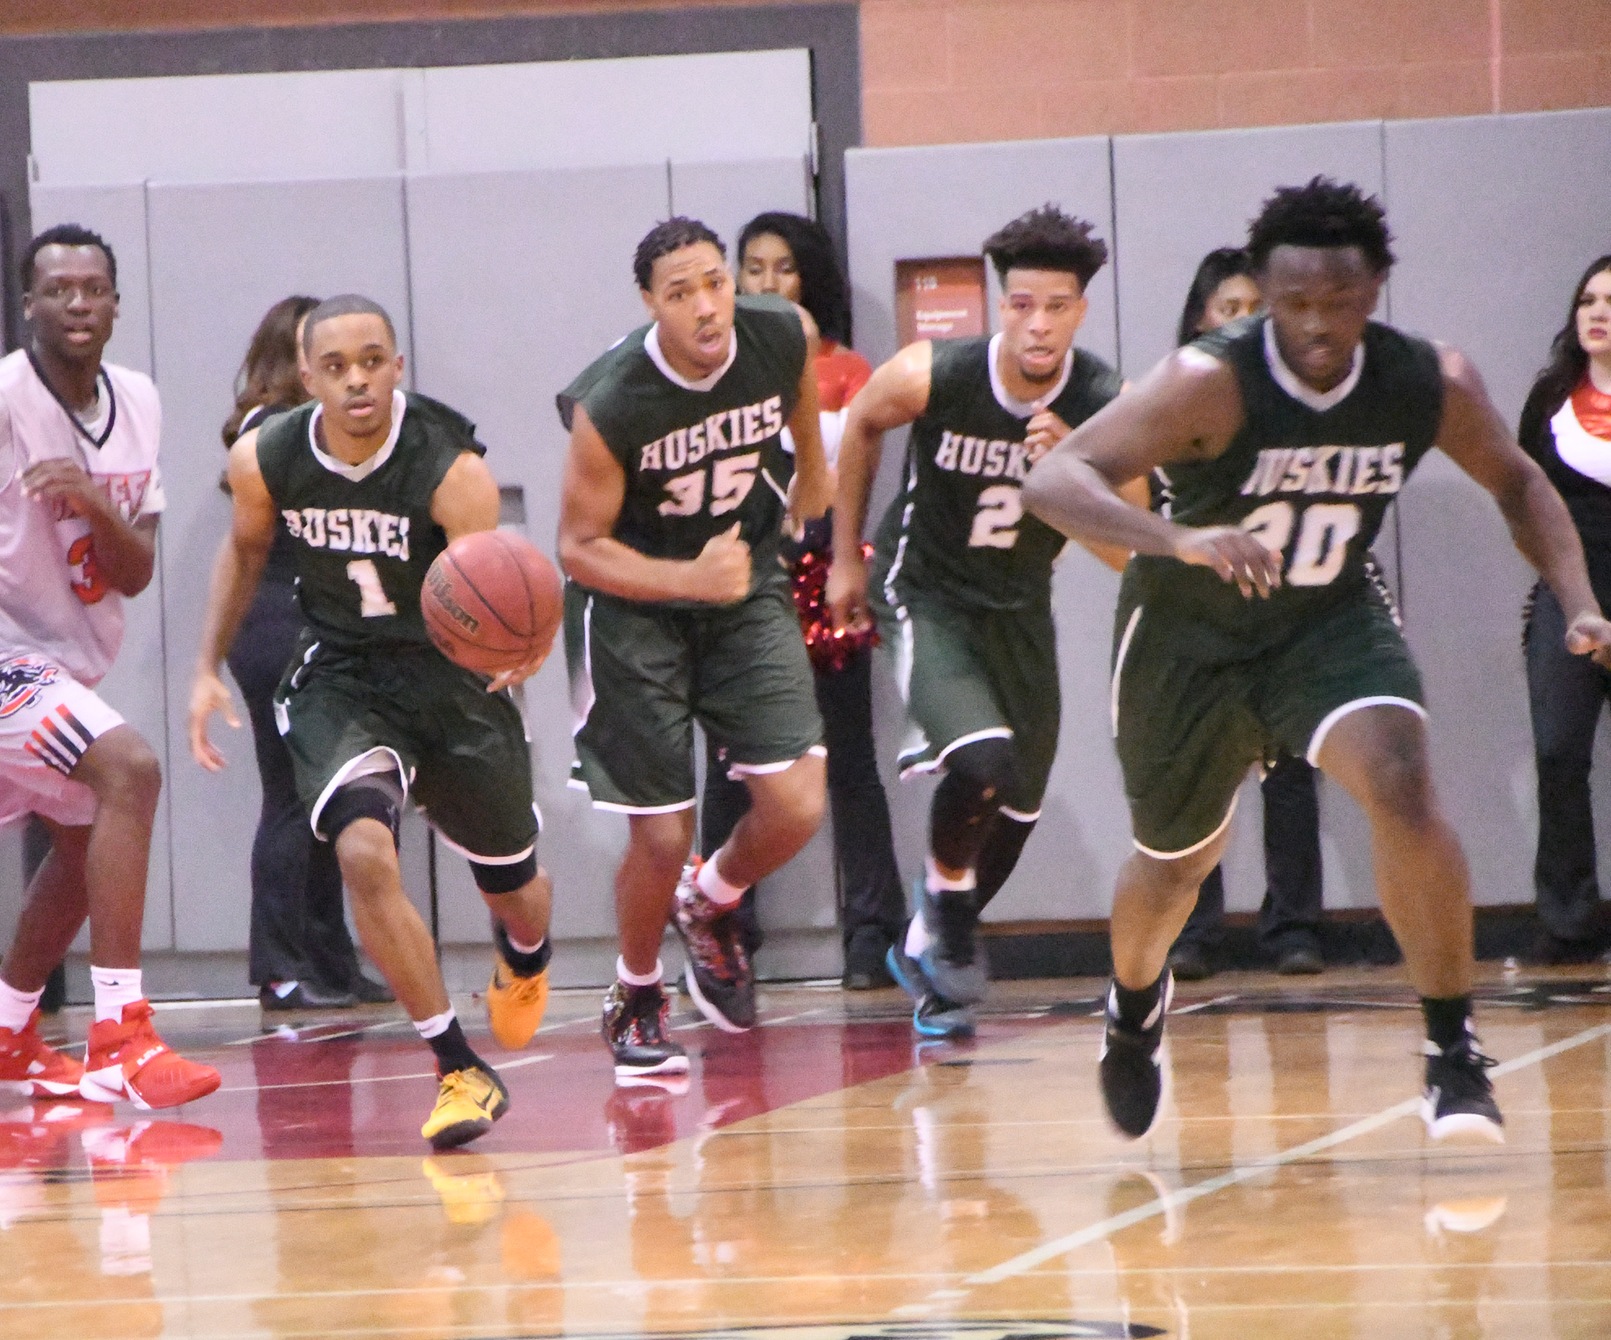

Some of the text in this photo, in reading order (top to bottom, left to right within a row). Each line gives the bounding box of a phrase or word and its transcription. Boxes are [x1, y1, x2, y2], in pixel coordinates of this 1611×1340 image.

[639, 395, 782, 472] HUSKIES
[935, 430, 1027, 480] HUSK
[658, 451, 760, 517] 35
[346, 559, 397, 618] 1
